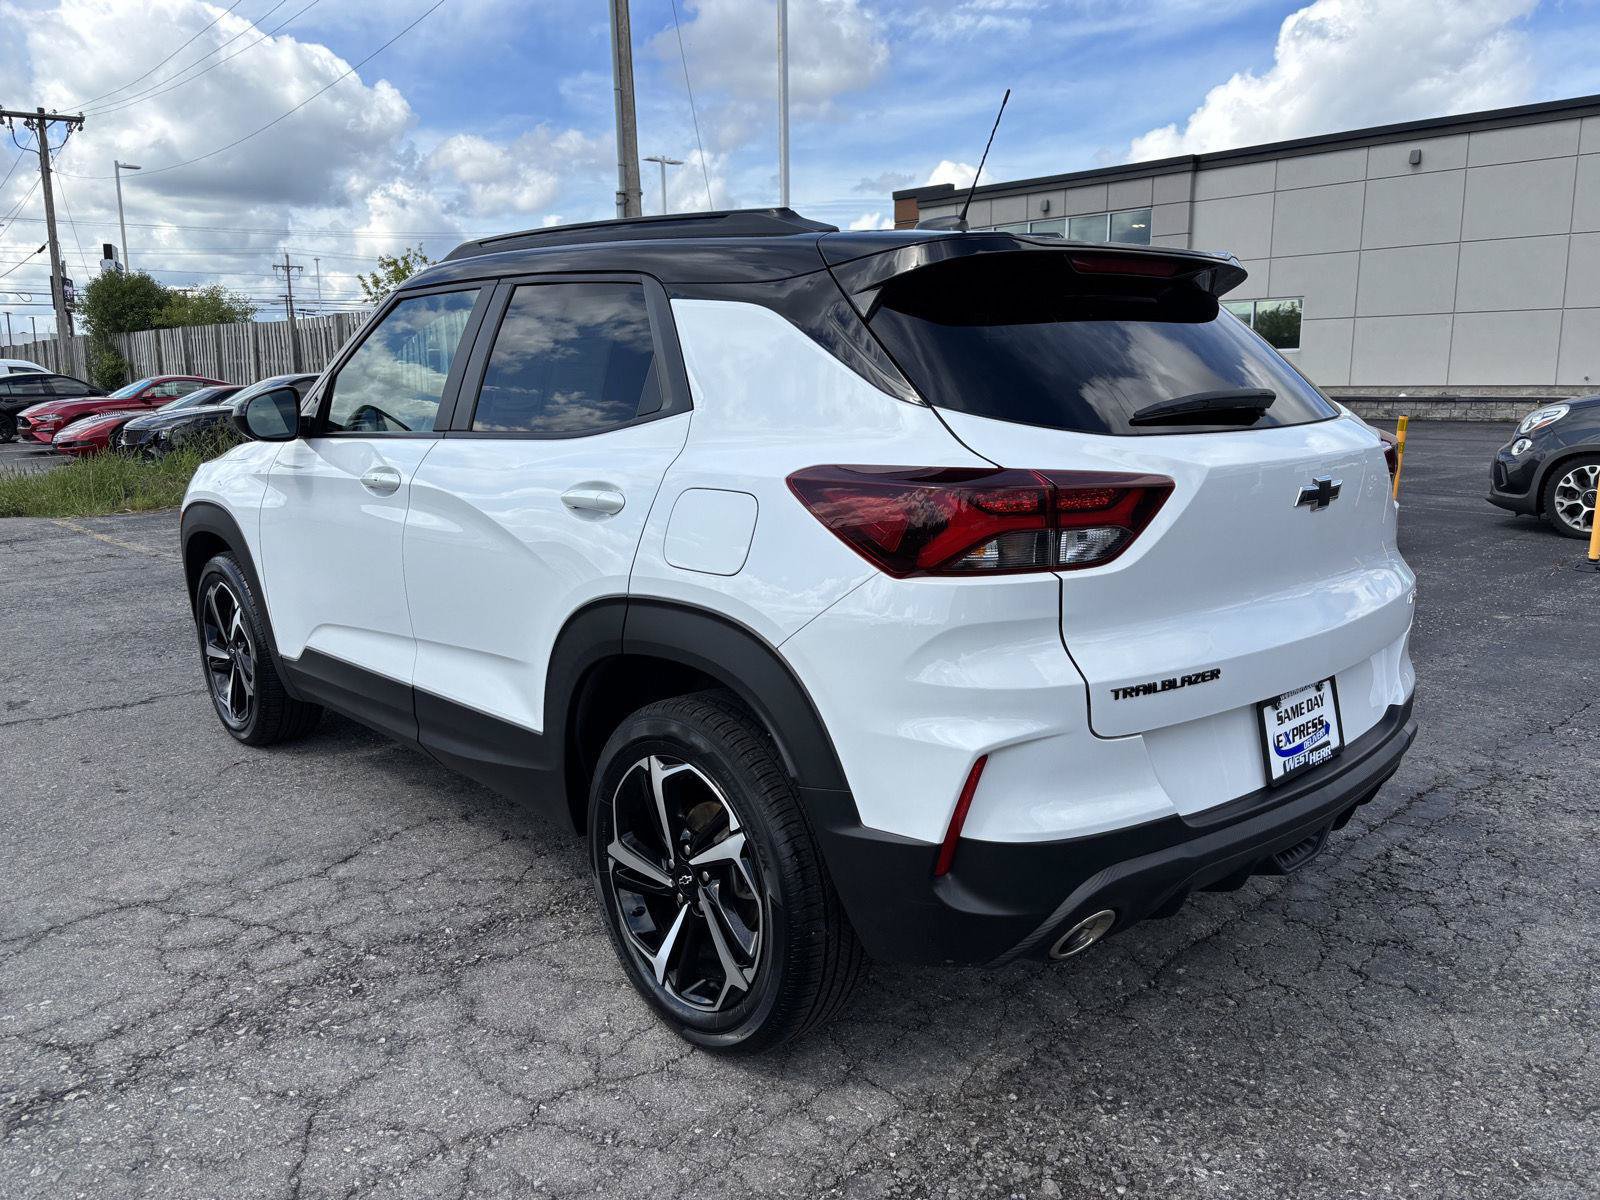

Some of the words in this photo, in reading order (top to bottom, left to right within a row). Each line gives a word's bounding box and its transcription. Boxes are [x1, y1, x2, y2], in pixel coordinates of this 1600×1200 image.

[1110, 668, 1221, 701] TRAILBLAZER
[1276, 701, 1305, 726] SAME
[1306, 692, 1325, 713] DAY
[1276, 714, 1324, 748] EXPRESS
[1303, 729, 1326, 750] DELIVERY
